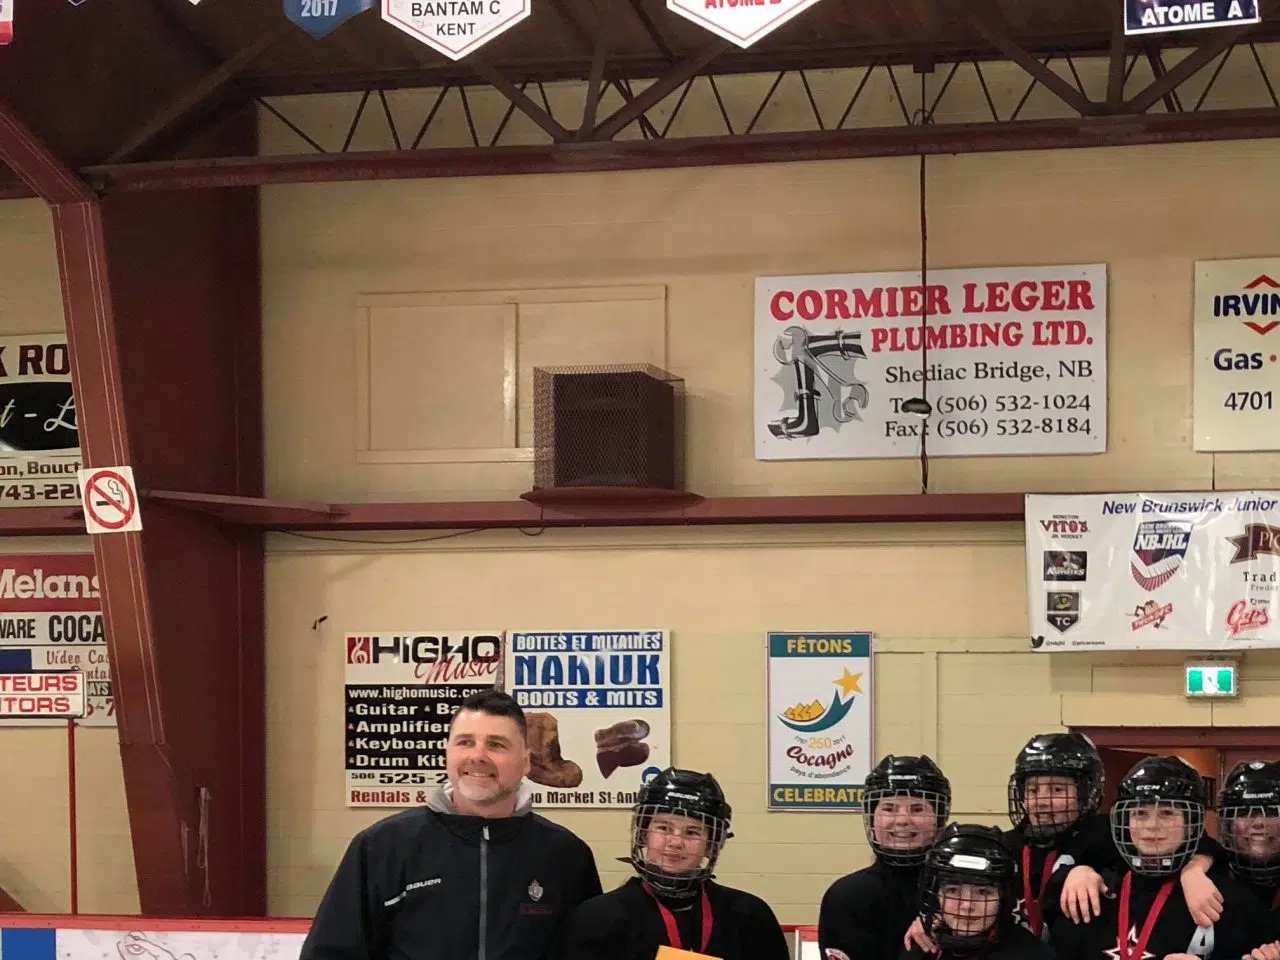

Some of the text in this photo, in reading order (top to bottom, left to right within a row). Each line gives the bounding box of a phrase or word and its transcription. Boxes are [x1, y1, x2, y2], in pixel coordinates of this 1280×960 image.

[301, 0, 338, 17] 2017
[411, 1, 501, 17] BANTAM C
[1141, 1, 1244, 26] ATOME A
[436, 22, 476, 36] KENT
[770, 280, 1096, 321] CORMIER LEGER
[871, 320, 1094, 353] PLUMBING LTD.
[1213, 348, 1264, 371] Gas
[885, 360, 1094, 384] Shediac Bridge, NB
[936, 394, 988, 414] (506)
[996, 394, 1092, 413] 532-1024
[1224, 391, 1274, 411] 4701
[936, 419, 989, 439] (506)
[996, 418, 1092, 437] 532-8184
[0, 465, 24, 477] n,
[1102, 500, 1137, 515] New
[1141, 498, 1223, 513] Brunswick
[1229, 497, 1277, 512] Junior
[372, 635, 501, 664] HIGHO
[516, 632, 661, 651] BOTTES ET MITAINES
[787, 637, 853, 654] FÊTONS
[514, 654, 661, 686] NAKIUK
[87, 682, 109, 696] AYS
[0, 697, 70, 713] TORS
[517, 690, 658, 706] BOOTS & MITS
[355, 703, 418, 716] Guitar
[356, 720, 451, 734] Amplifier
[356, 754, 409, 767] Drum
[786, 744, 854, 770] Cocagne
[351, 772, 375, 780] 506
[351, 790, 427, 803] Rentals &
[547, 791, 595, 804] Market
